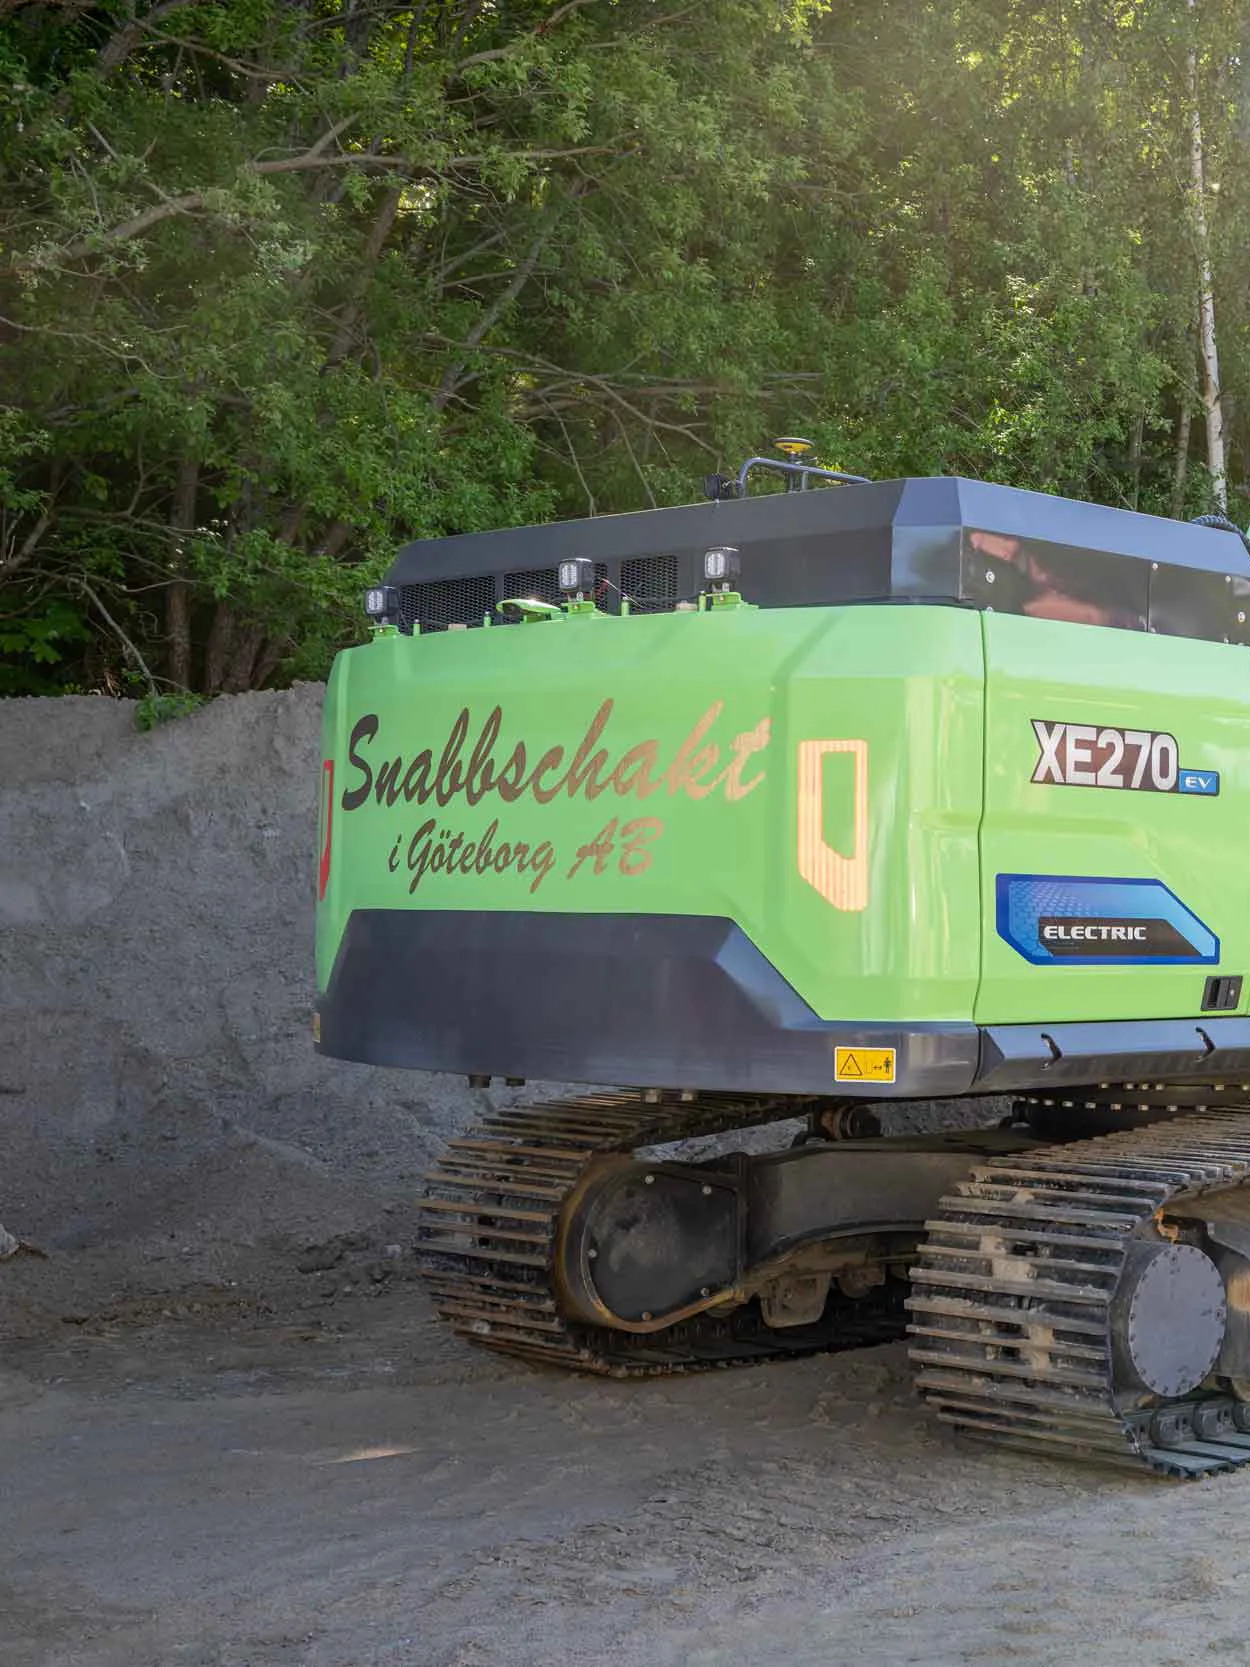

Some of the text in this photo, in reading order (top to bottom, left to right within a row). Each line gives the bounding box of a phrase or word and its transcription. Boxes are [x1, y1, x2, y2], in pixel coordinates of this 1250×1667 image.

[342, 698, 771, 811] Snabbschakt
[1032, 721, 1213, 791] XE270 EV
[389, 816, 664, 894] i Göteborg AB
[1043, 925, 1147, 940] ELECTRIC
